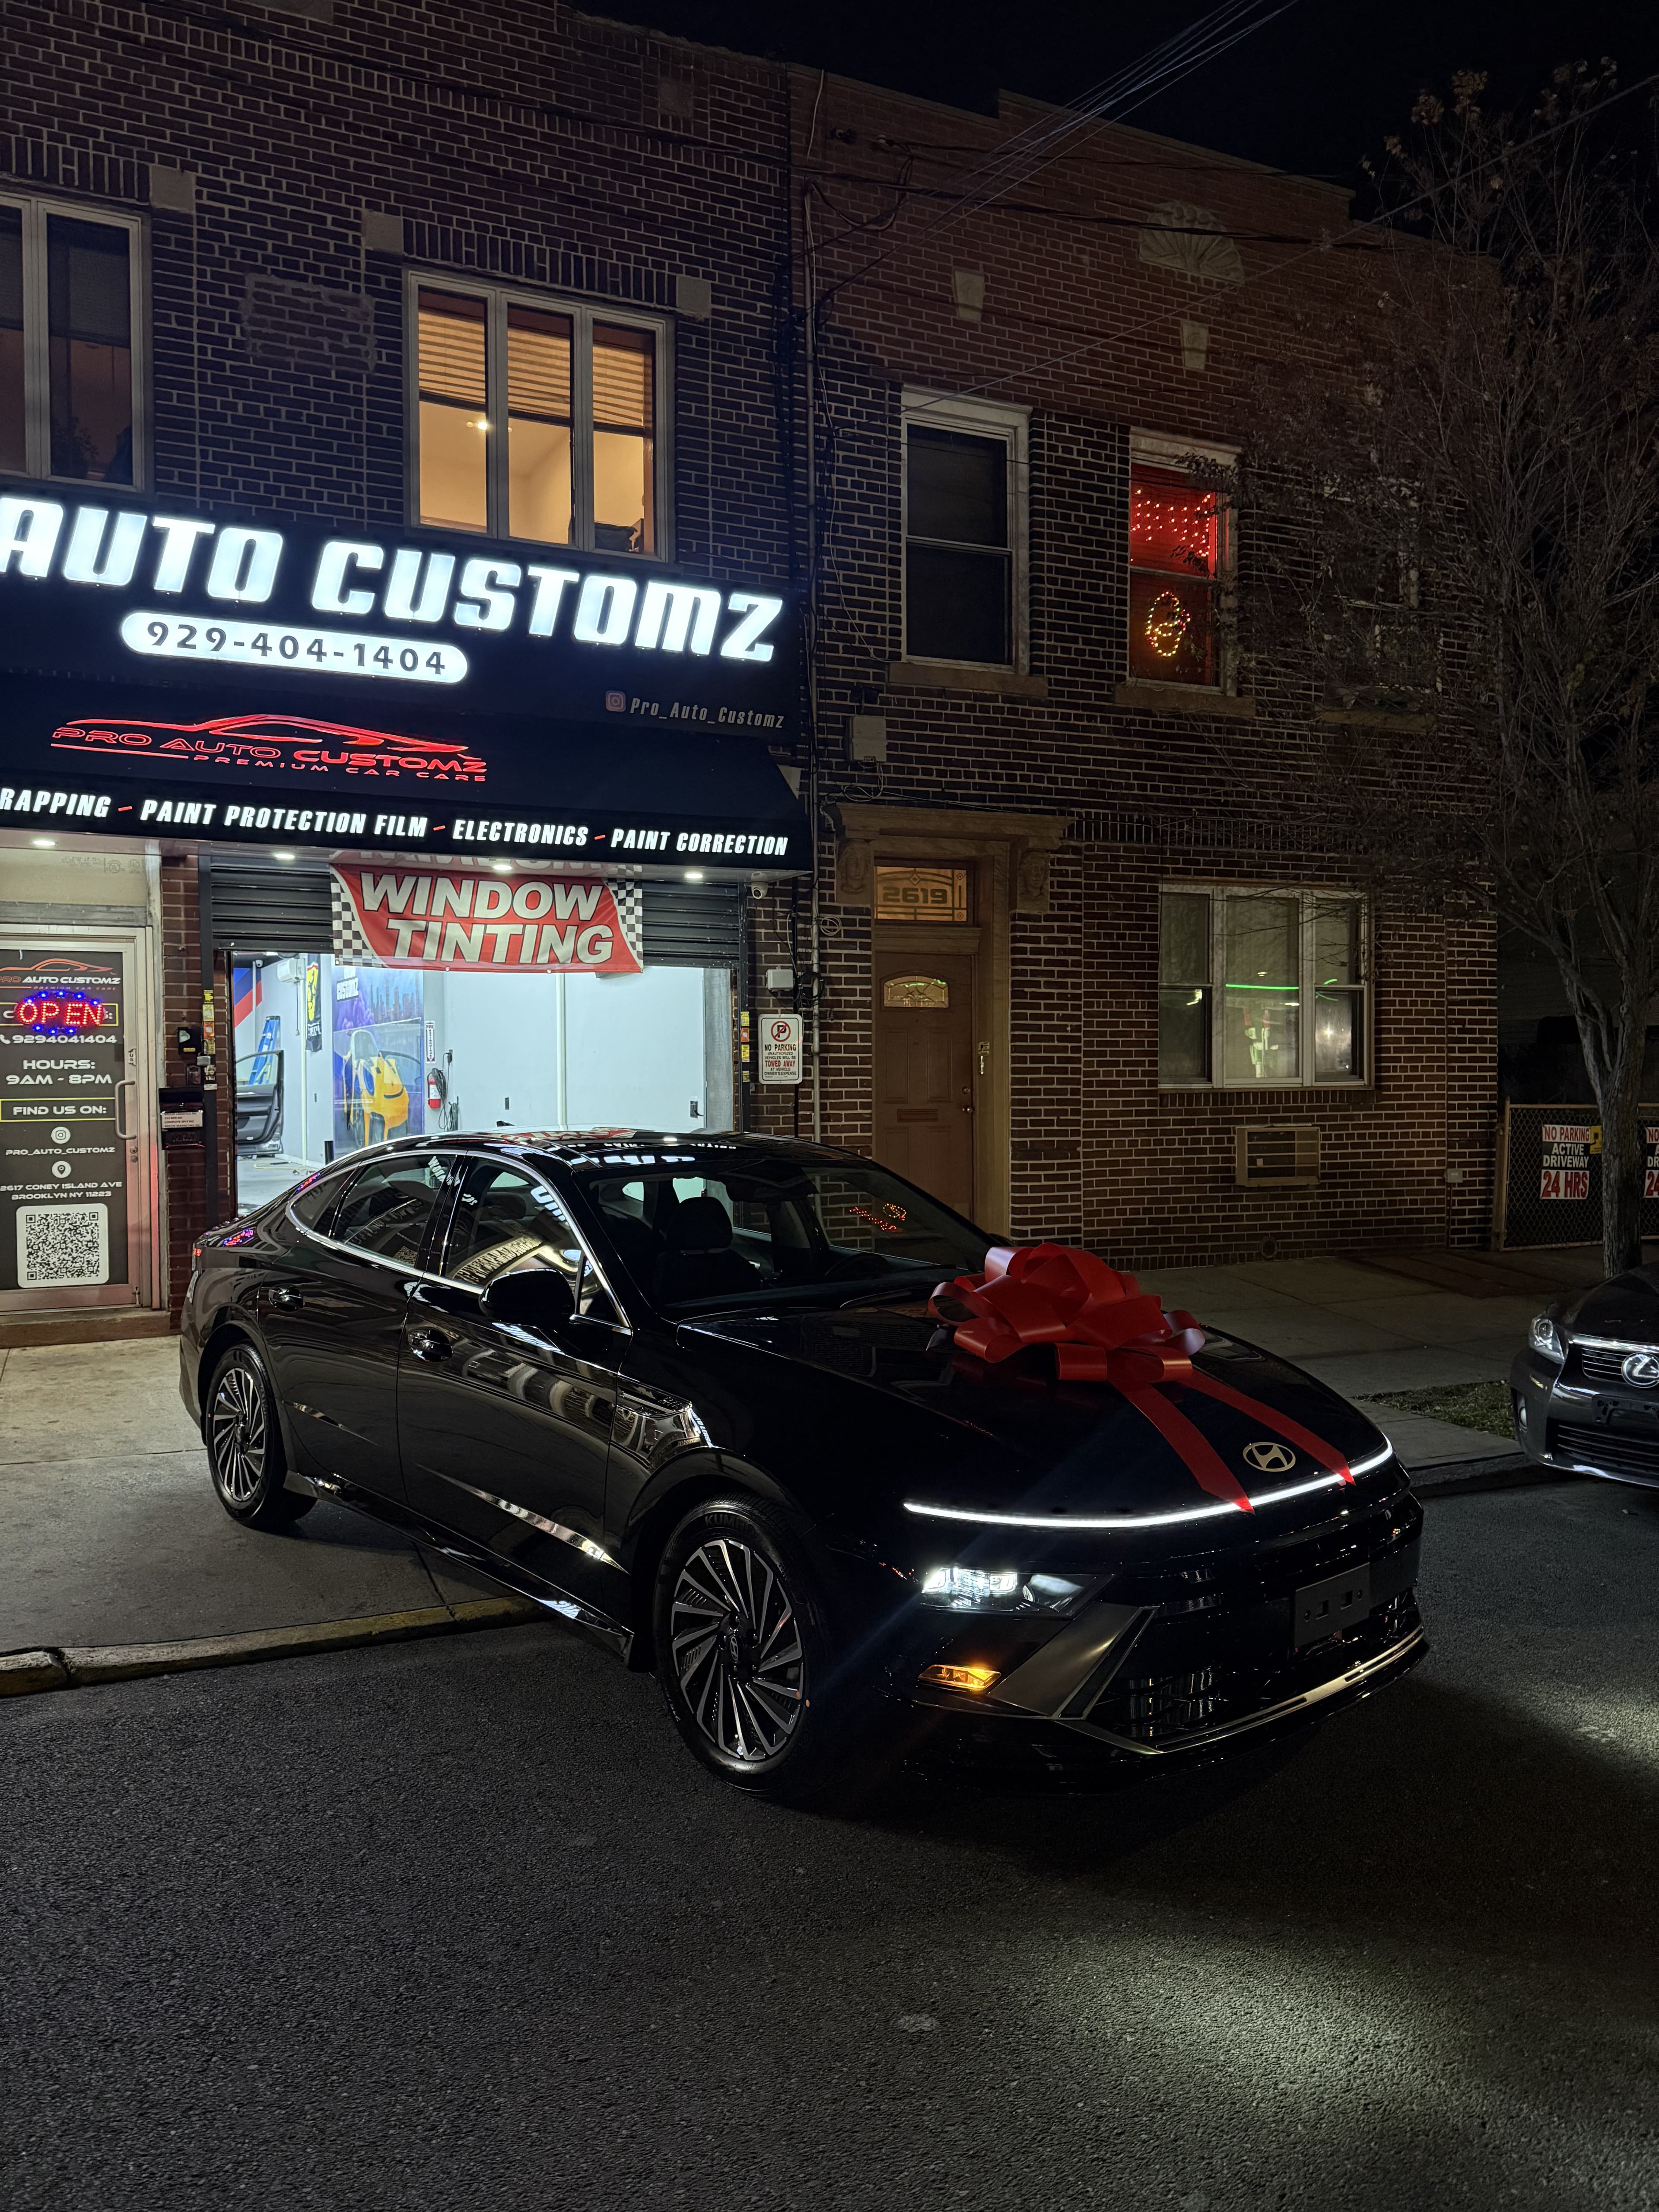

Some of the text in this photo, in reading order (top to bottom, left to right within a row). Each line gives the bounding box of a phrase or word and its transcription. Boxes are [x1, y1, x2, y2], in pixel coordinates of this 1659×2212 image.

[0, 497, 783, 662] AUTO CUSTOMZ
[147, 621, 445, 674] 929-404-1404
[630, 698, 784, 729] Pro_Auto_Customz
[52, 728, 487, 773] PRO AUTO CUSTOMZ
[194, 754, 486, 782] PREMIUM CAR CARE
[0, 788, 111, 817] RAPPING
[140, 799, 217, 826] PAINT
[224, 807, 367, 834] PROTECTION
[374, 815, 429, 838] FILM
[452, 819, 589, 847] ELECTRONICS
[610, 828, 671, 851] PAINT
[676, 833, 789, 856] CORRECTION
[360, 872, 604, 921] WINDOW
[882, 886, 947, 904] 2619
[387, 918, 614, 965] TINTING
[17, 1001, 103, 1027] OPEN
[12, 1035, 117, 1044] 9294041404
[23, 1060, 96, 1070] HOURS:
[6, 1074, 53, 1085] 9AM
[69, 1074, 112, 1084] 8PM
[13, 1106, 107, 1115] FIND US ON:
[1544, 1127, 1590, 1142] NO PARKING
[6, 1147, 115, 1156] PRO_AUTO_CUSTOMZ
[1543, 1155, 1589, 1168] DRIVEWAY
[1551, 1143, 1584, 1156] ACTIVE
[1541, 1170, 1588, 1198] 24 HRS
